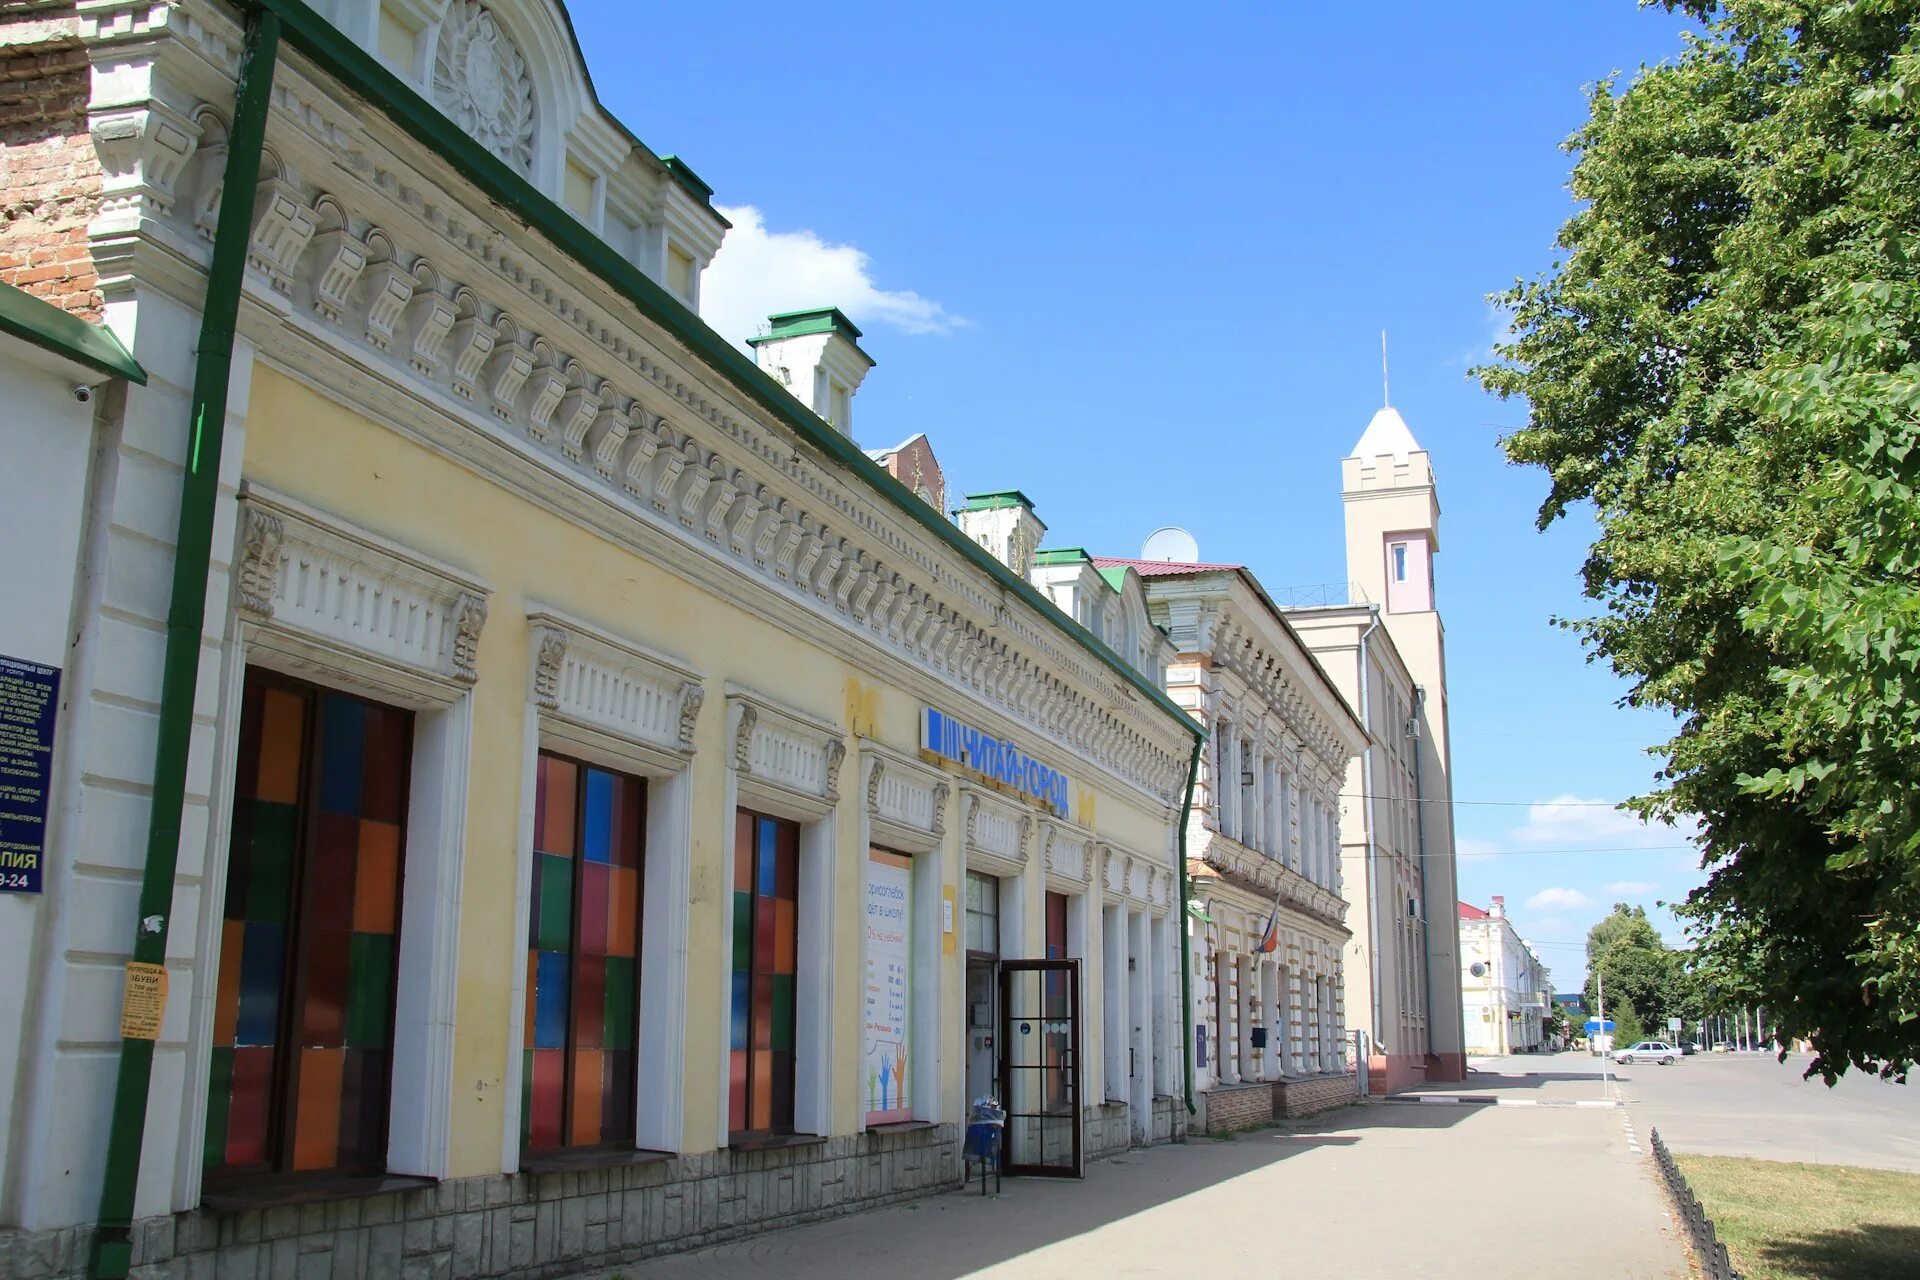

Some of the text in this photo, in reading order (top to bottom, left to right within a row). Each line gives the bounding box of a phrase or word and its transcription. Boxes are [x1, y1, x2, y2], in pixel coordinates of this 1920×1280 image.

[0, 659, 36, 672] МАЦИОННЫЙ
[19, 686, 37, 696] ЧИСЛЕ
[25, 680, 34, 688] ПО
[36, 682, 52, 691] ВСЕМ
[15, 708, 41, 719] ПЕРЕНОС
[25, 728, 38, 736] ДЛЯ
[962, 724, 1070, 820] ЧИТАЙ-ГОРОД
